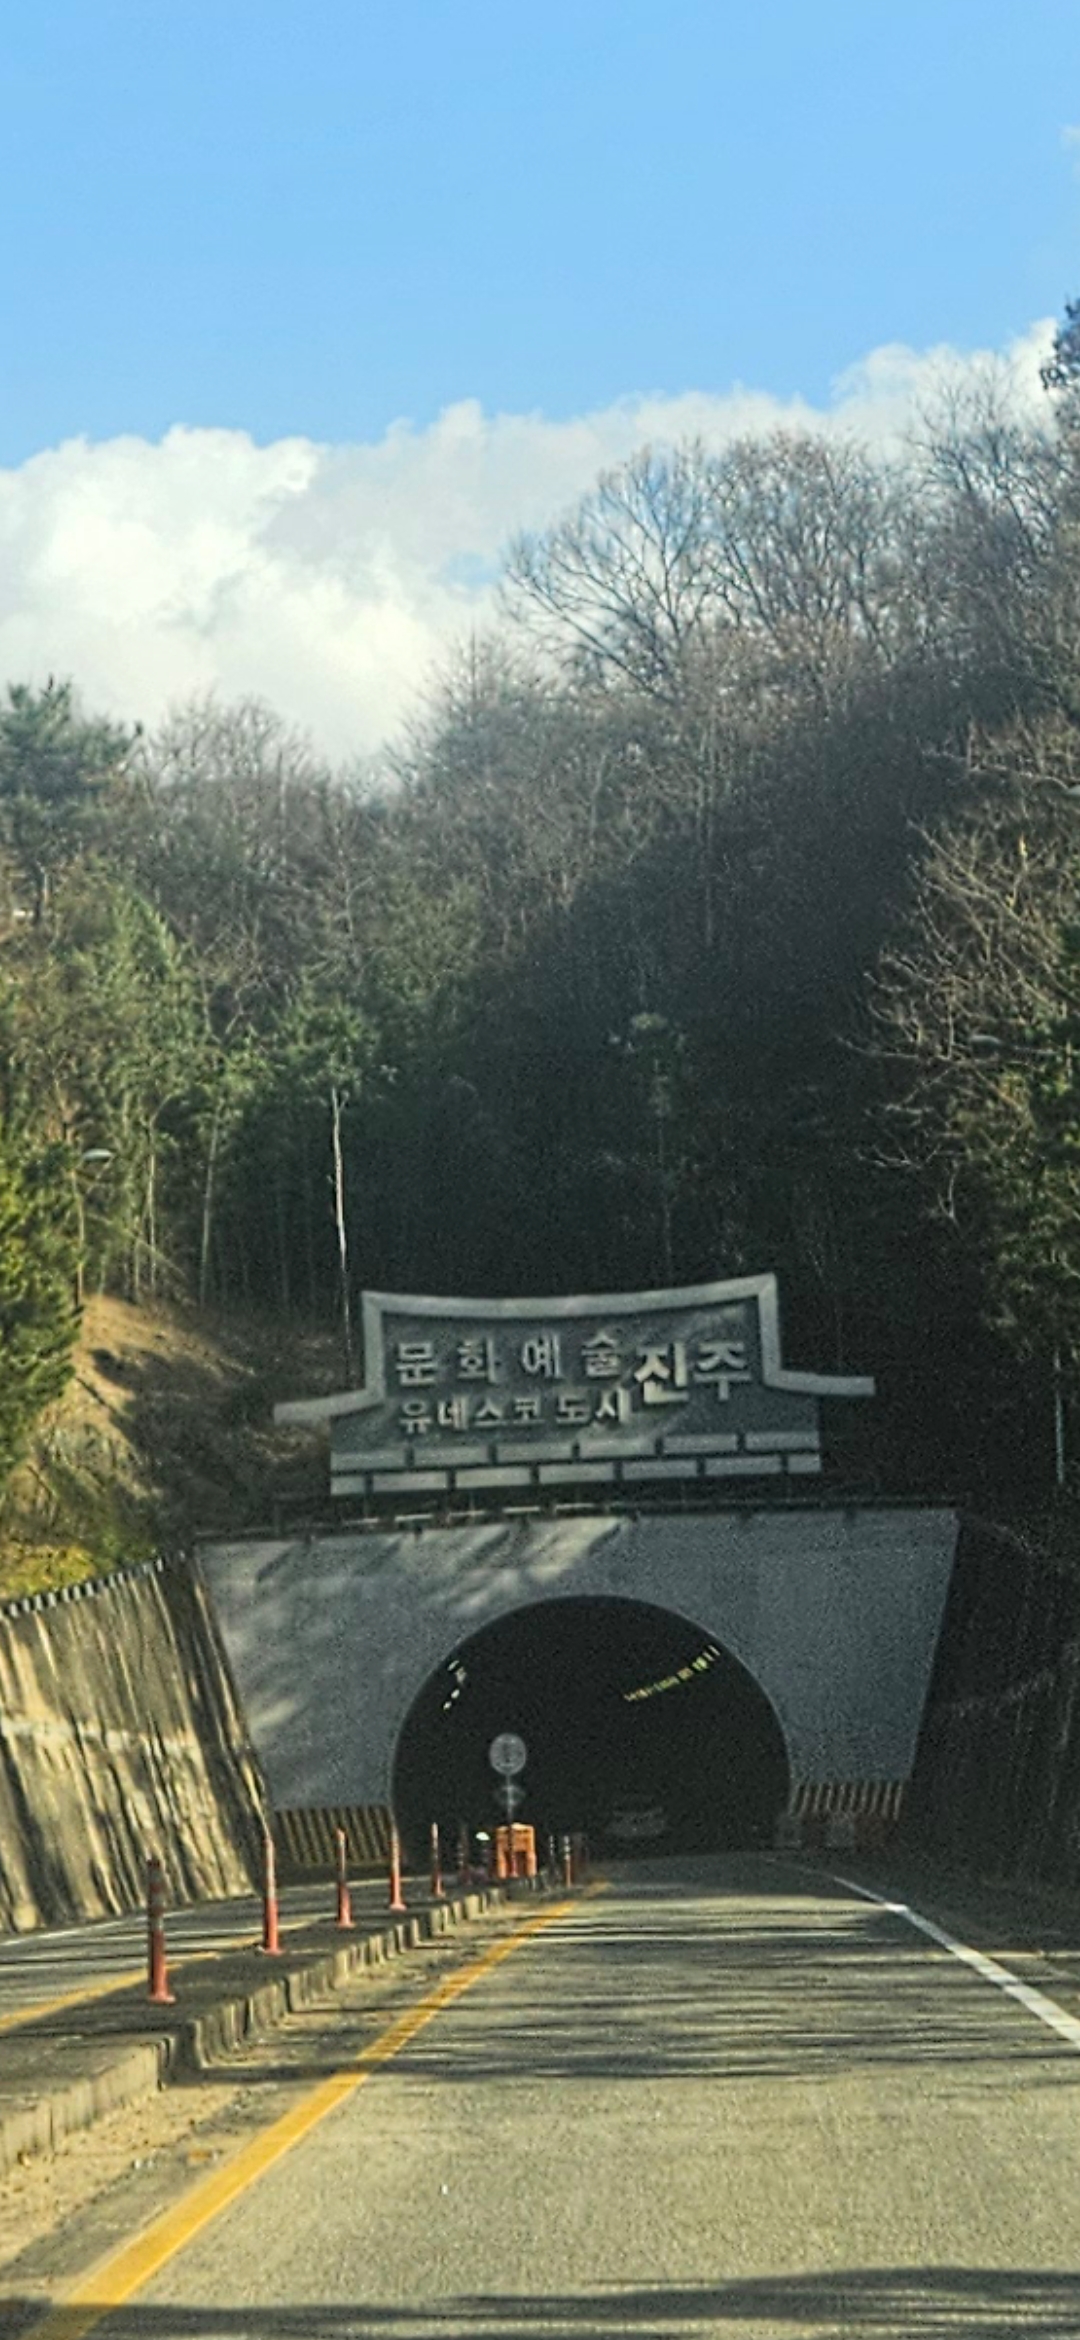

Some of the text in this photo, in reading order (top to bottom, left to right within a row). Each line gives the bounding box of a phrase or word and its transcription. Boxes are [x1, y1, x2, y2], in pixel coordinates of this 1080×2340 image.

[396, 1330, 624, 1386] 문화 예술
[634, 1340, 752, 1405] 진주
[400, 1386, 632, 1434] 유네스코 도시
